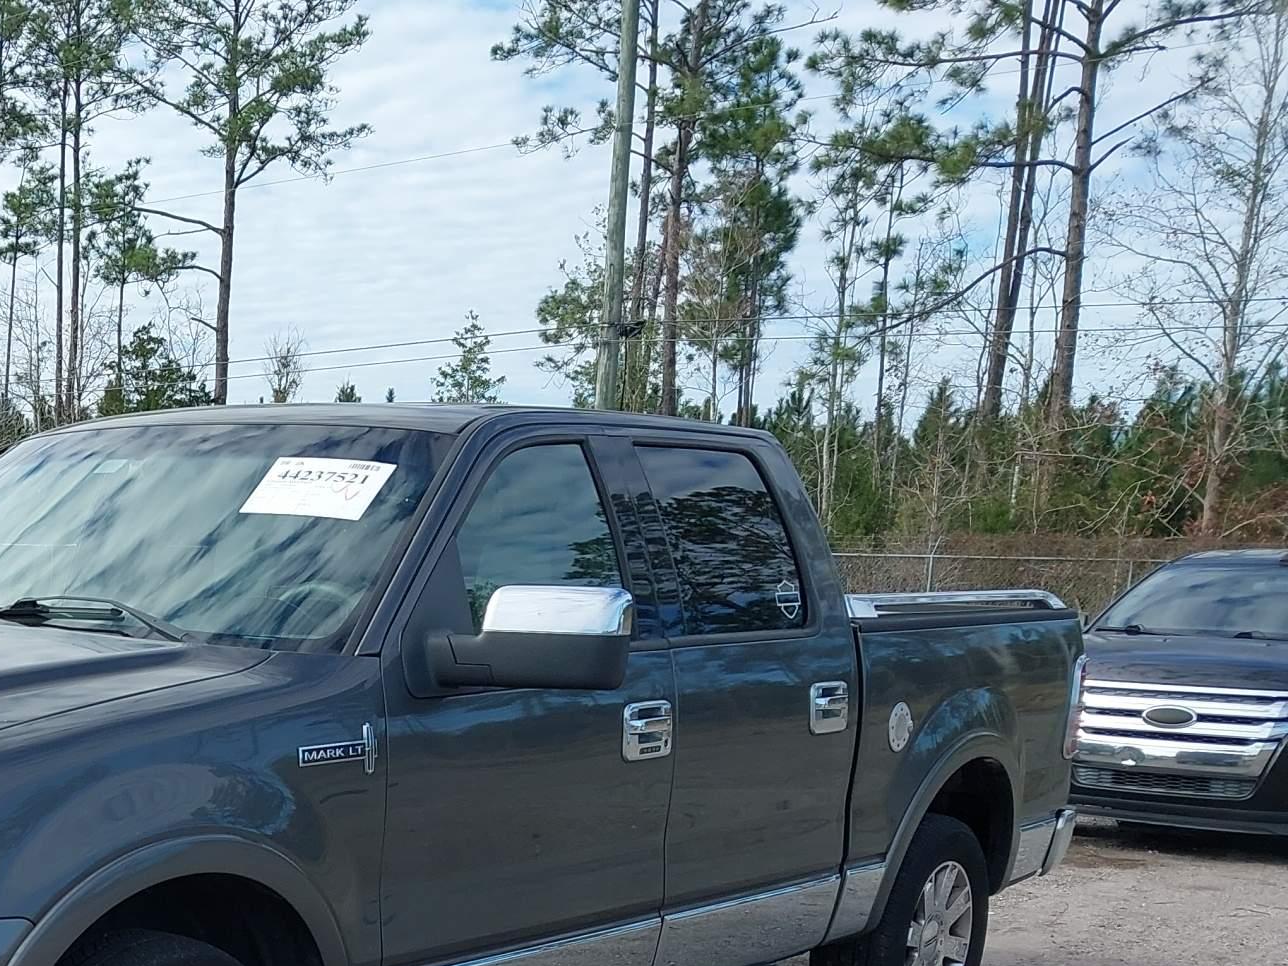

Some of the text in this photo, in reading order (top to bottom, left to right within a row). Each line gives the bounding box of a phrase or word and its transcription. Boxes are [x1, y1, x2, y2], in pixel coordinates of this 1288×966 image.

[277, 469, 370, 485] 44237521
[304, 744, 364, 761] MARK LT
